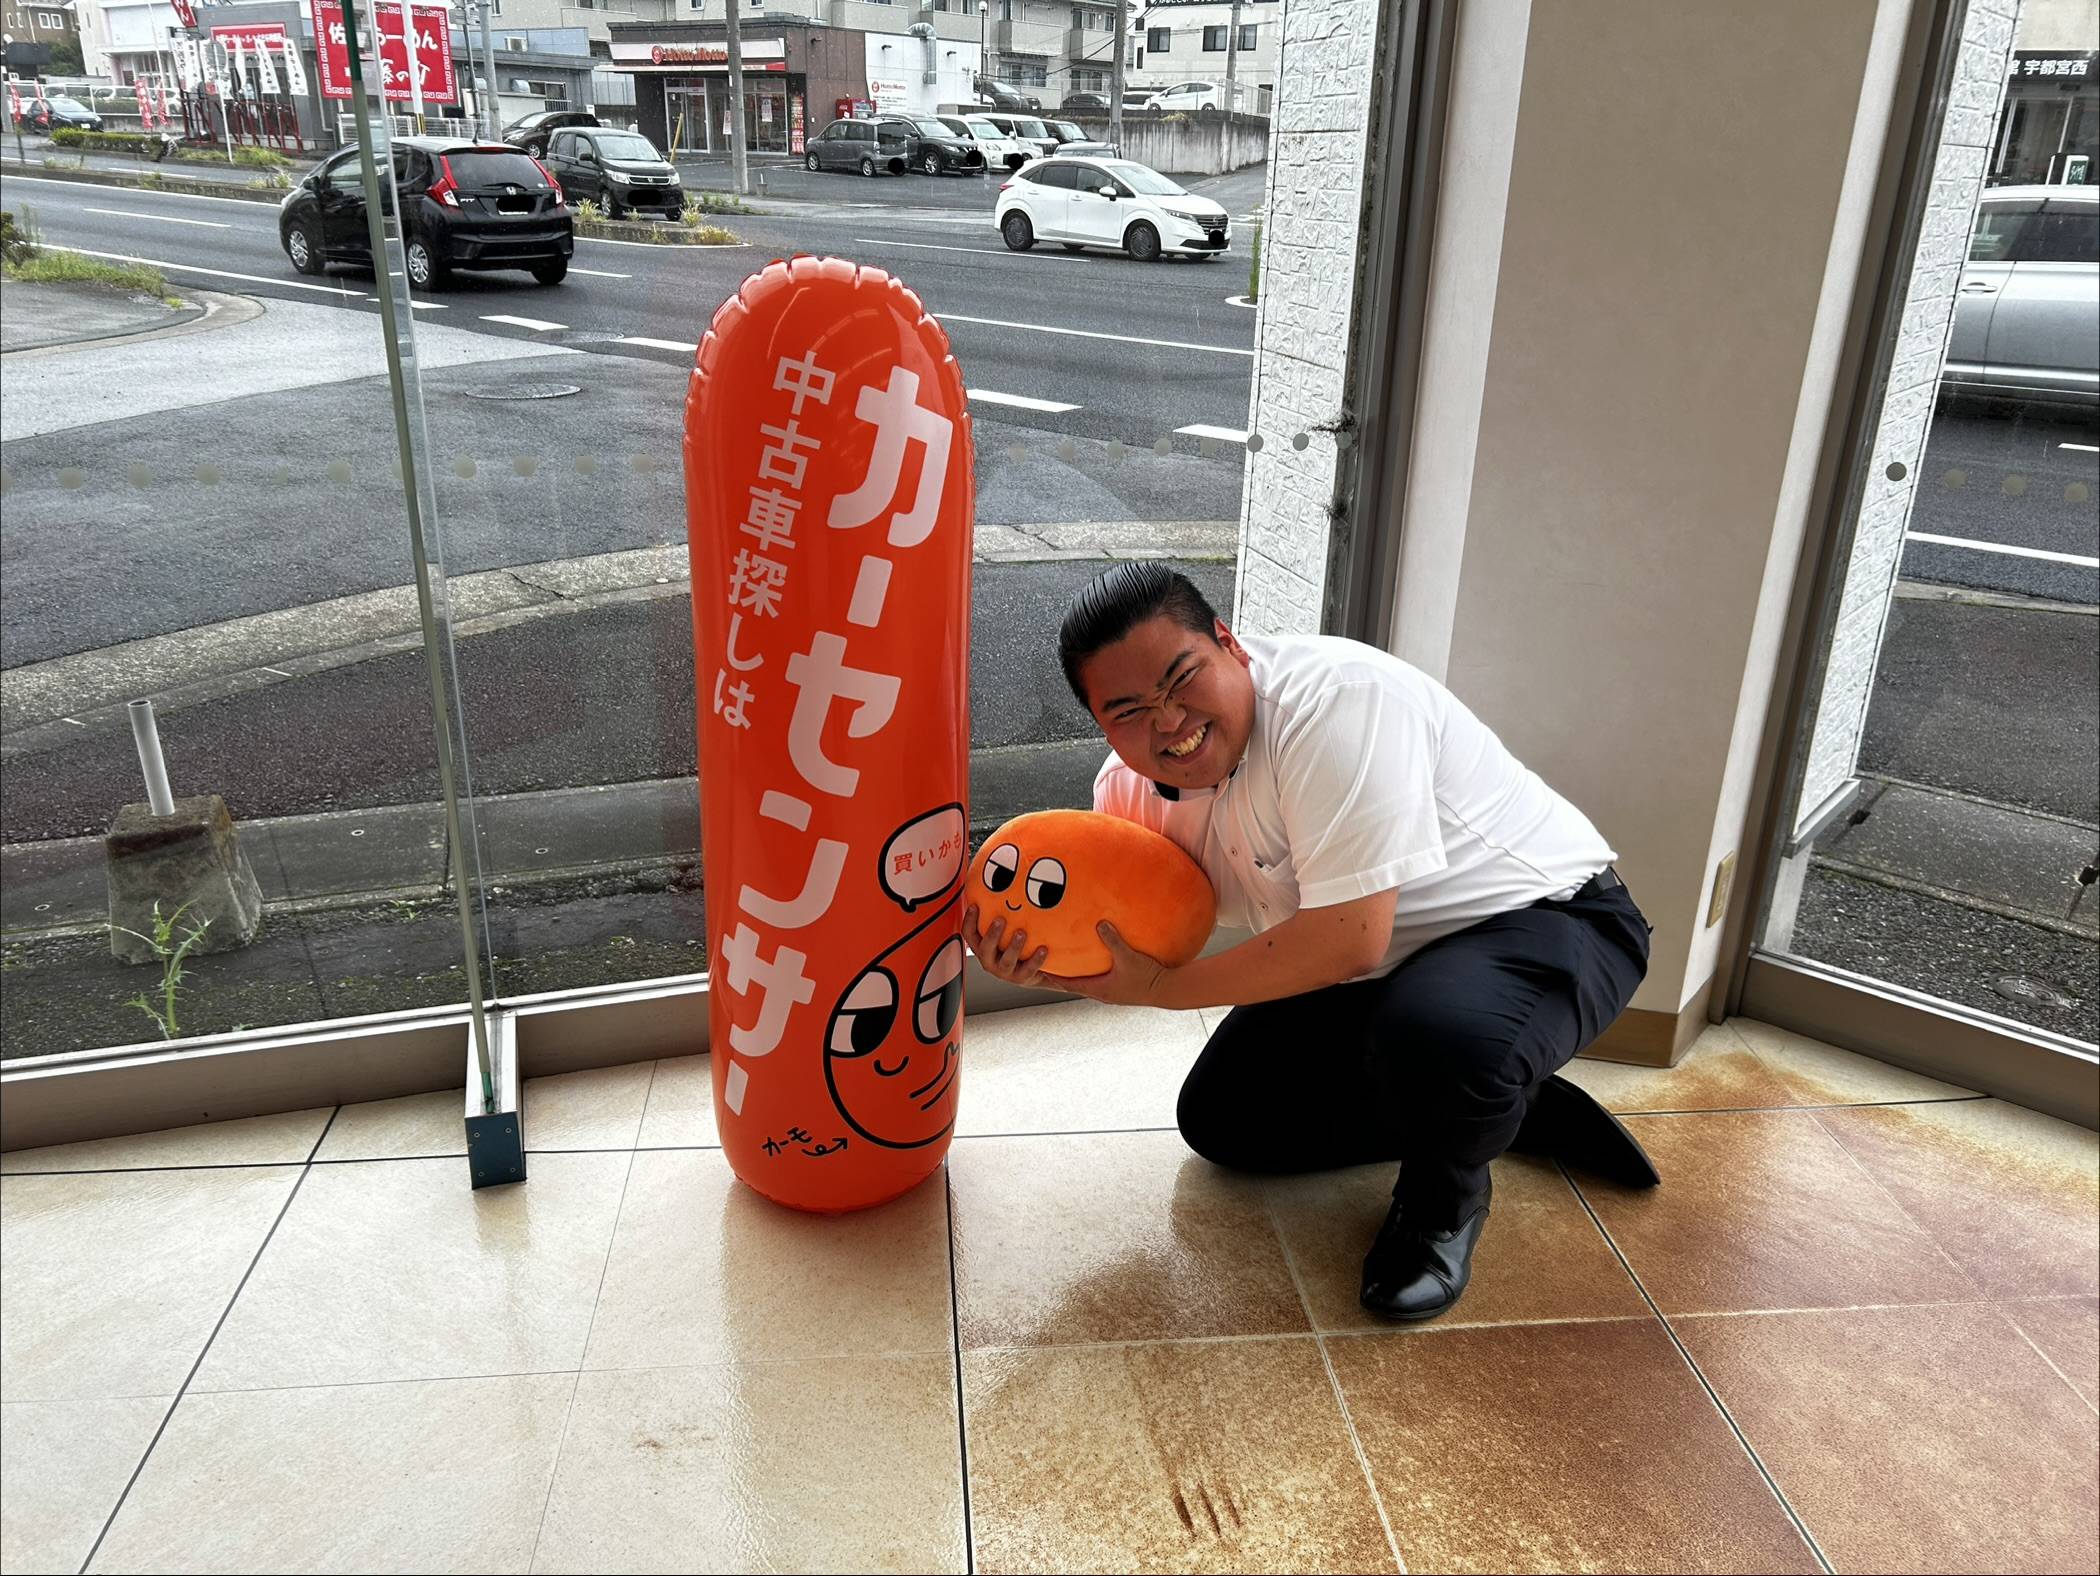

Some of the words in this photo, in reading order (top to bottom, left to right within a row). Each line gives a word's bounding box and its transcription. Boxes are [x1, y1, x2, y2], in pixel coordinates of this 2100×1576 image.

[2024, 59, 2089, 76] 宇都宮西
[713, 351, 836, 730] 中古車探しは
[721, 365, 953, 1117] カーセンサー
[894, 832, 962, 876] 買いかも
[761, 1126, 813, 1157] カーモ
